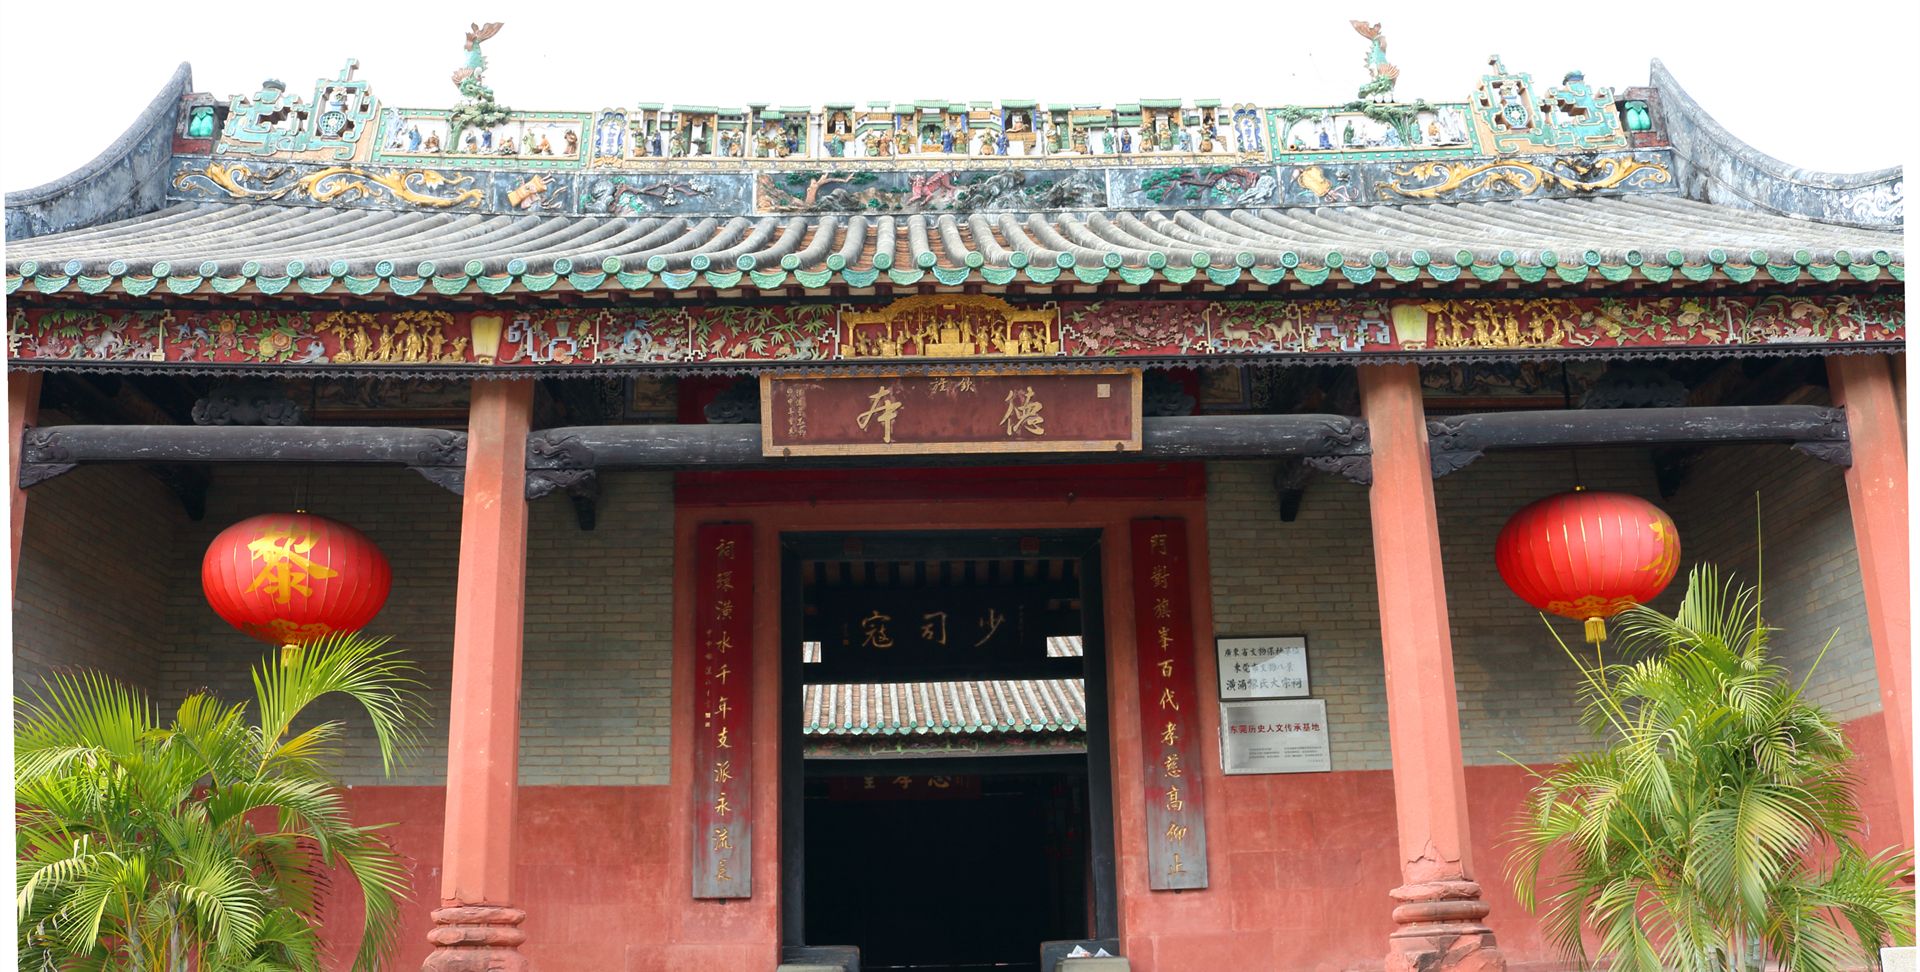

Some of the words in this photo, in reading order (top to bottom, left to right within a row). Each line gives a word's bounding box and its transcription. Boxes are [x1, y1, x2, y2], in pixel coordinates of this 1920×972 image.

[244, 522, 338, 604] 黎
[861, 608, 1005, 648] 少司寇
[1231, 723, 1320, 734] 东莞历史人文传承基地
